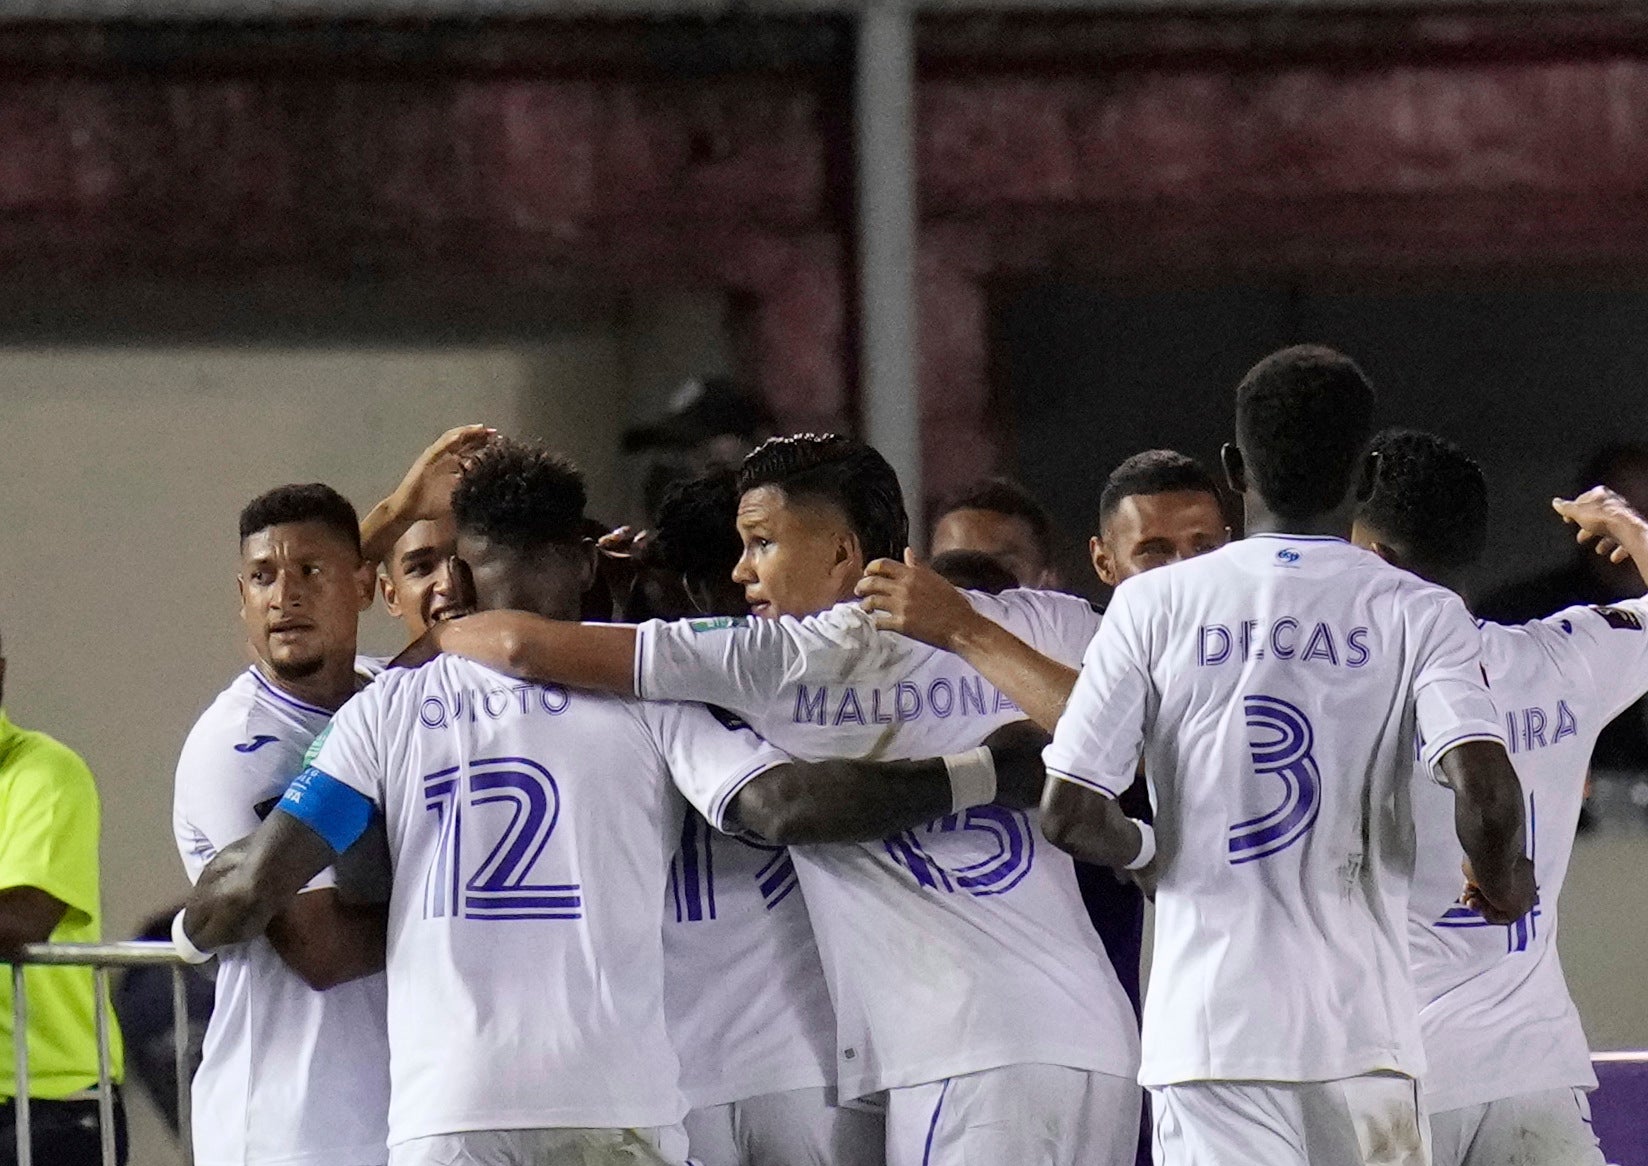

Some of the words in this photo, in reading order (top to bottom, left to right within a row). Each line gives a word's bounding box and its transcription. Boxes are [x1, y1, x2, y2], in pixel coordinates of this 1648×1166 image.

[1197, 616, 1371, 669] DECAS
[423, 757, 582, 921] 12
[1229, 695, 1322, 865] 3
